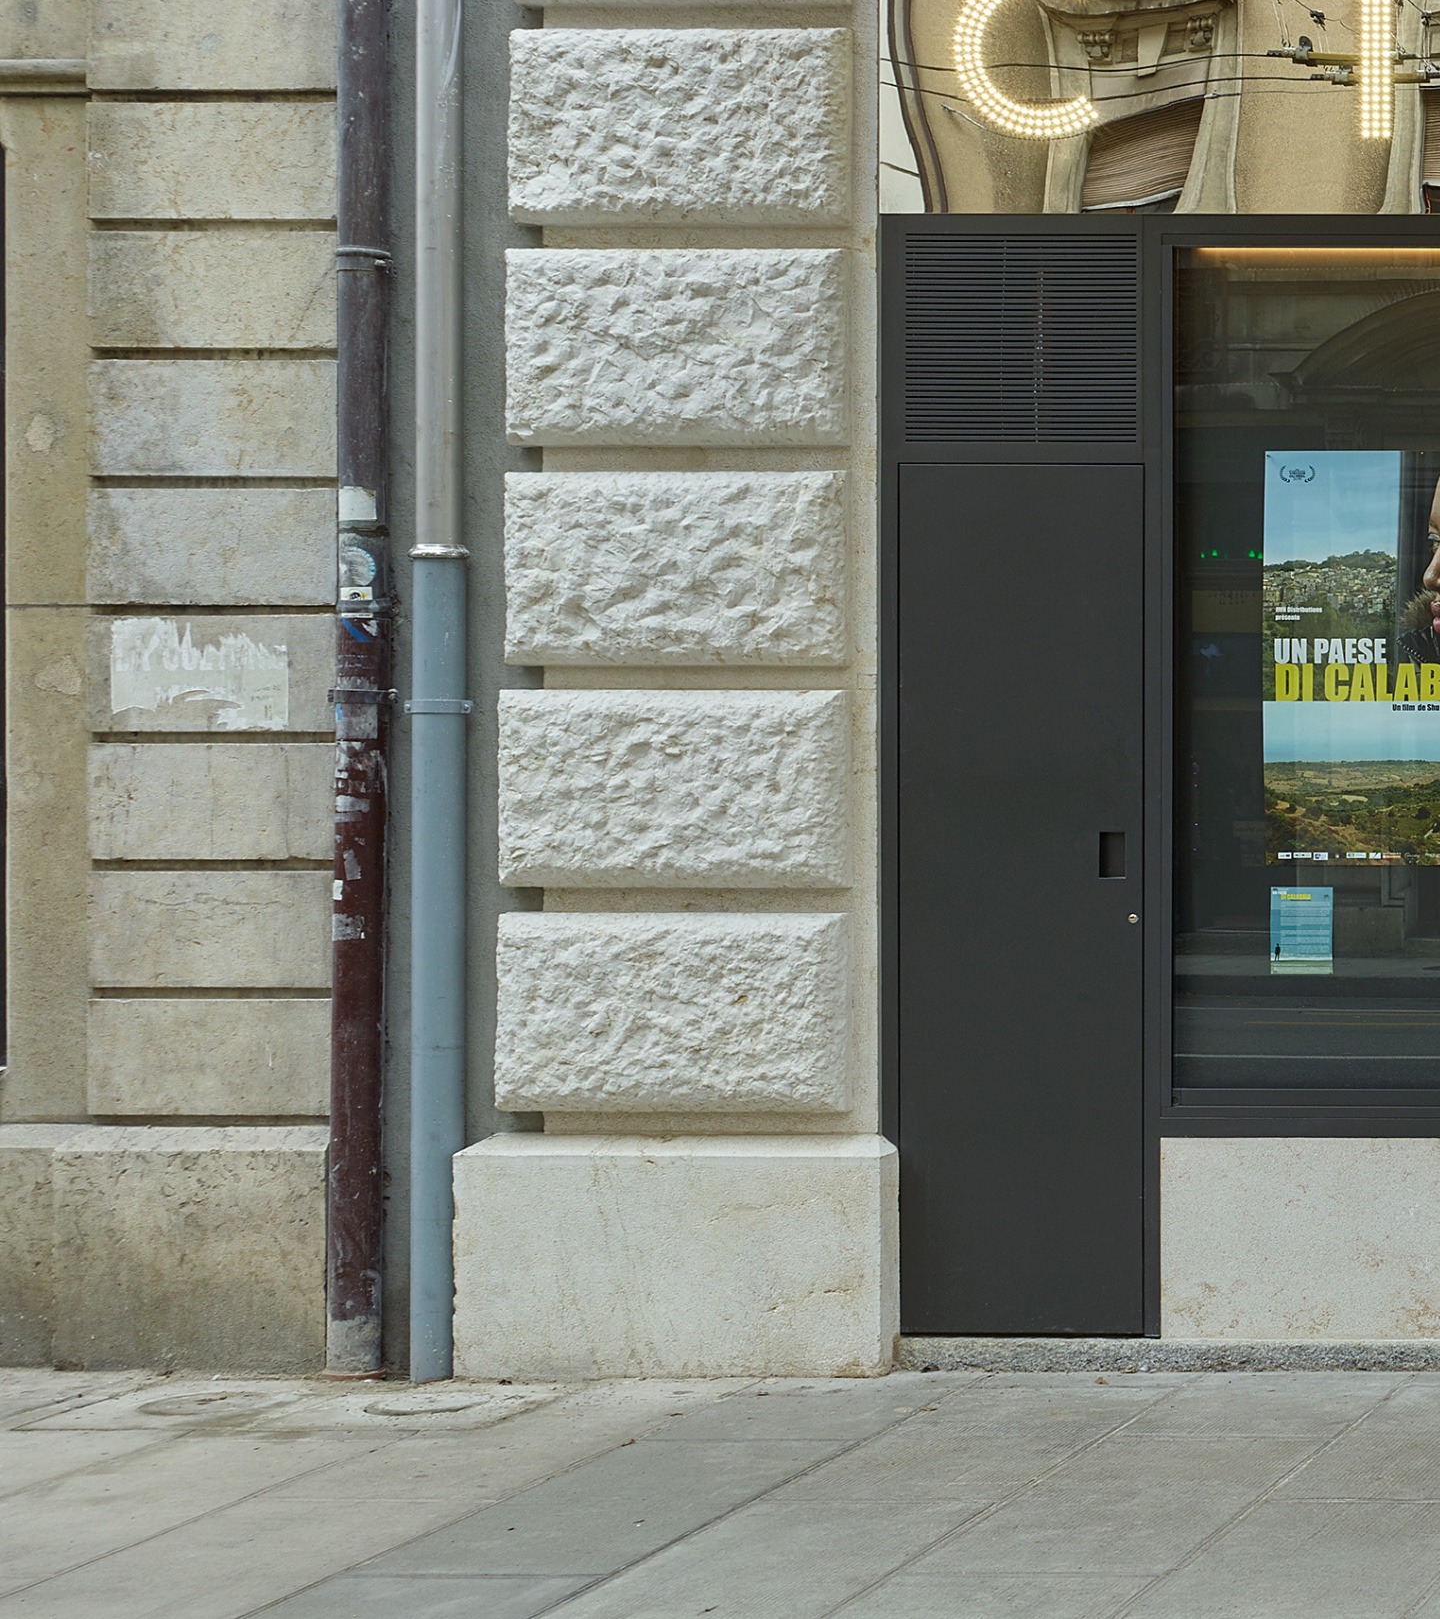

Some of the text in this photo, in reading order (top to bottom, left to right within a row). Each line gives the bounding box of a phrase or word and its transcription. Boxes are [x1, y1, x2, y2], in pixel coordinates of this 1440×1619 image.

[1274, 638, 1387, 664] UN PAESE
[1274, 662, 1314, 702] DI
[1392, 703, 1402, 712] Un
[1402, 703, 1416, 712] film
[1417, 703, 1426, 712] de
